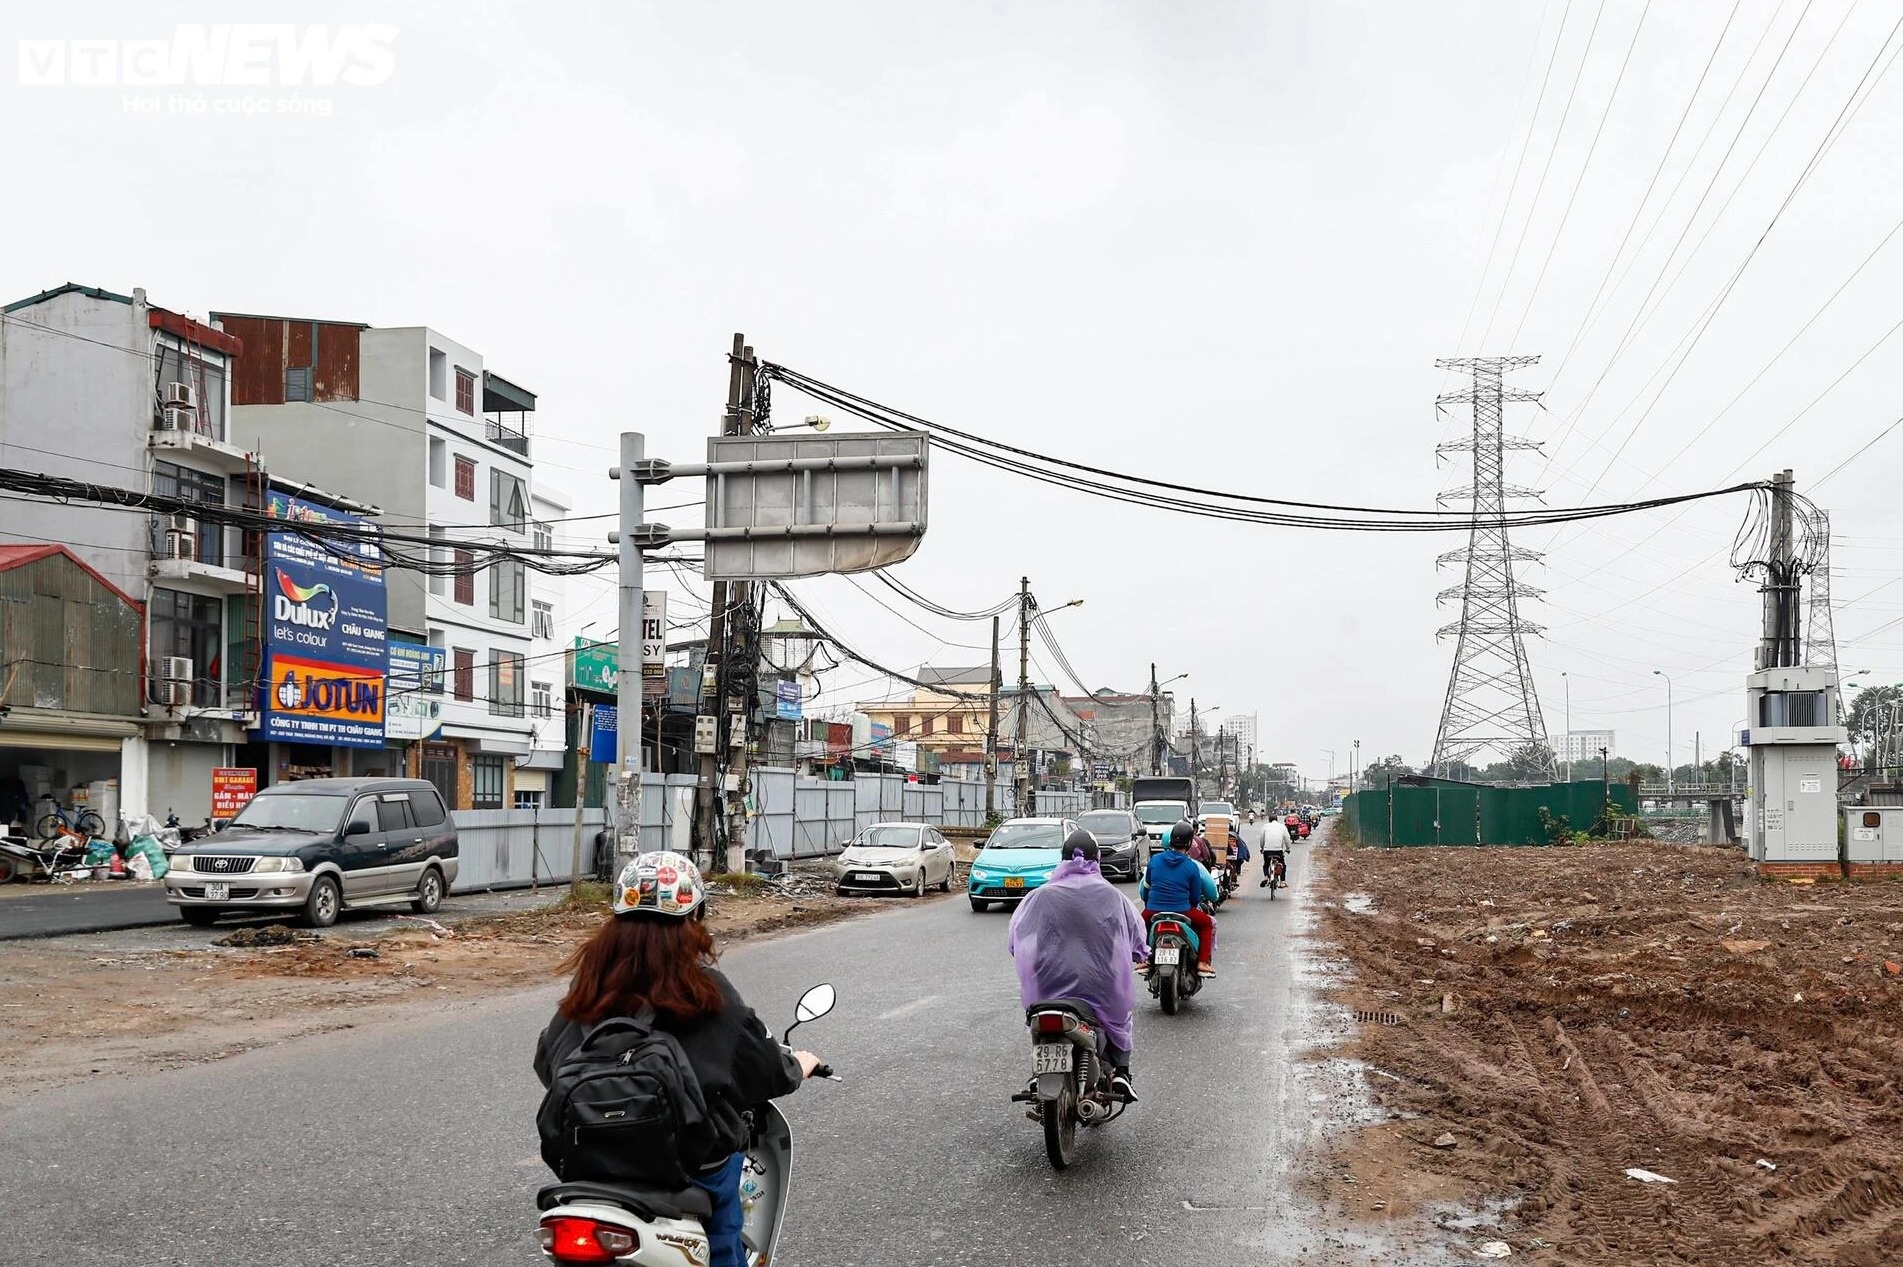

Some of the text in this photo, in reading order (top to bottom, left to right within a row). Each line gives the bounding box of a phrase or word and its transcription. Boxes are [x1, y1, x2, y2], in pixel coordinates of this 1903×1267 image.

[275, 593, 331, 630] Dulux
[274, 624, 294, 641] let's
[296, 631, 328, 648] colour
[342, 622, 385, 641] CHÂU GIANG
[642, 619, 662, 640] TEL
[302, 674, 378, 715] JOTUN
[270, 716, 290, 729] CÔNG
[291, 720, 300, 730] TY
[346, 723, 363, 735] CHÂU
[363, 727, 383, 737] GIANG
